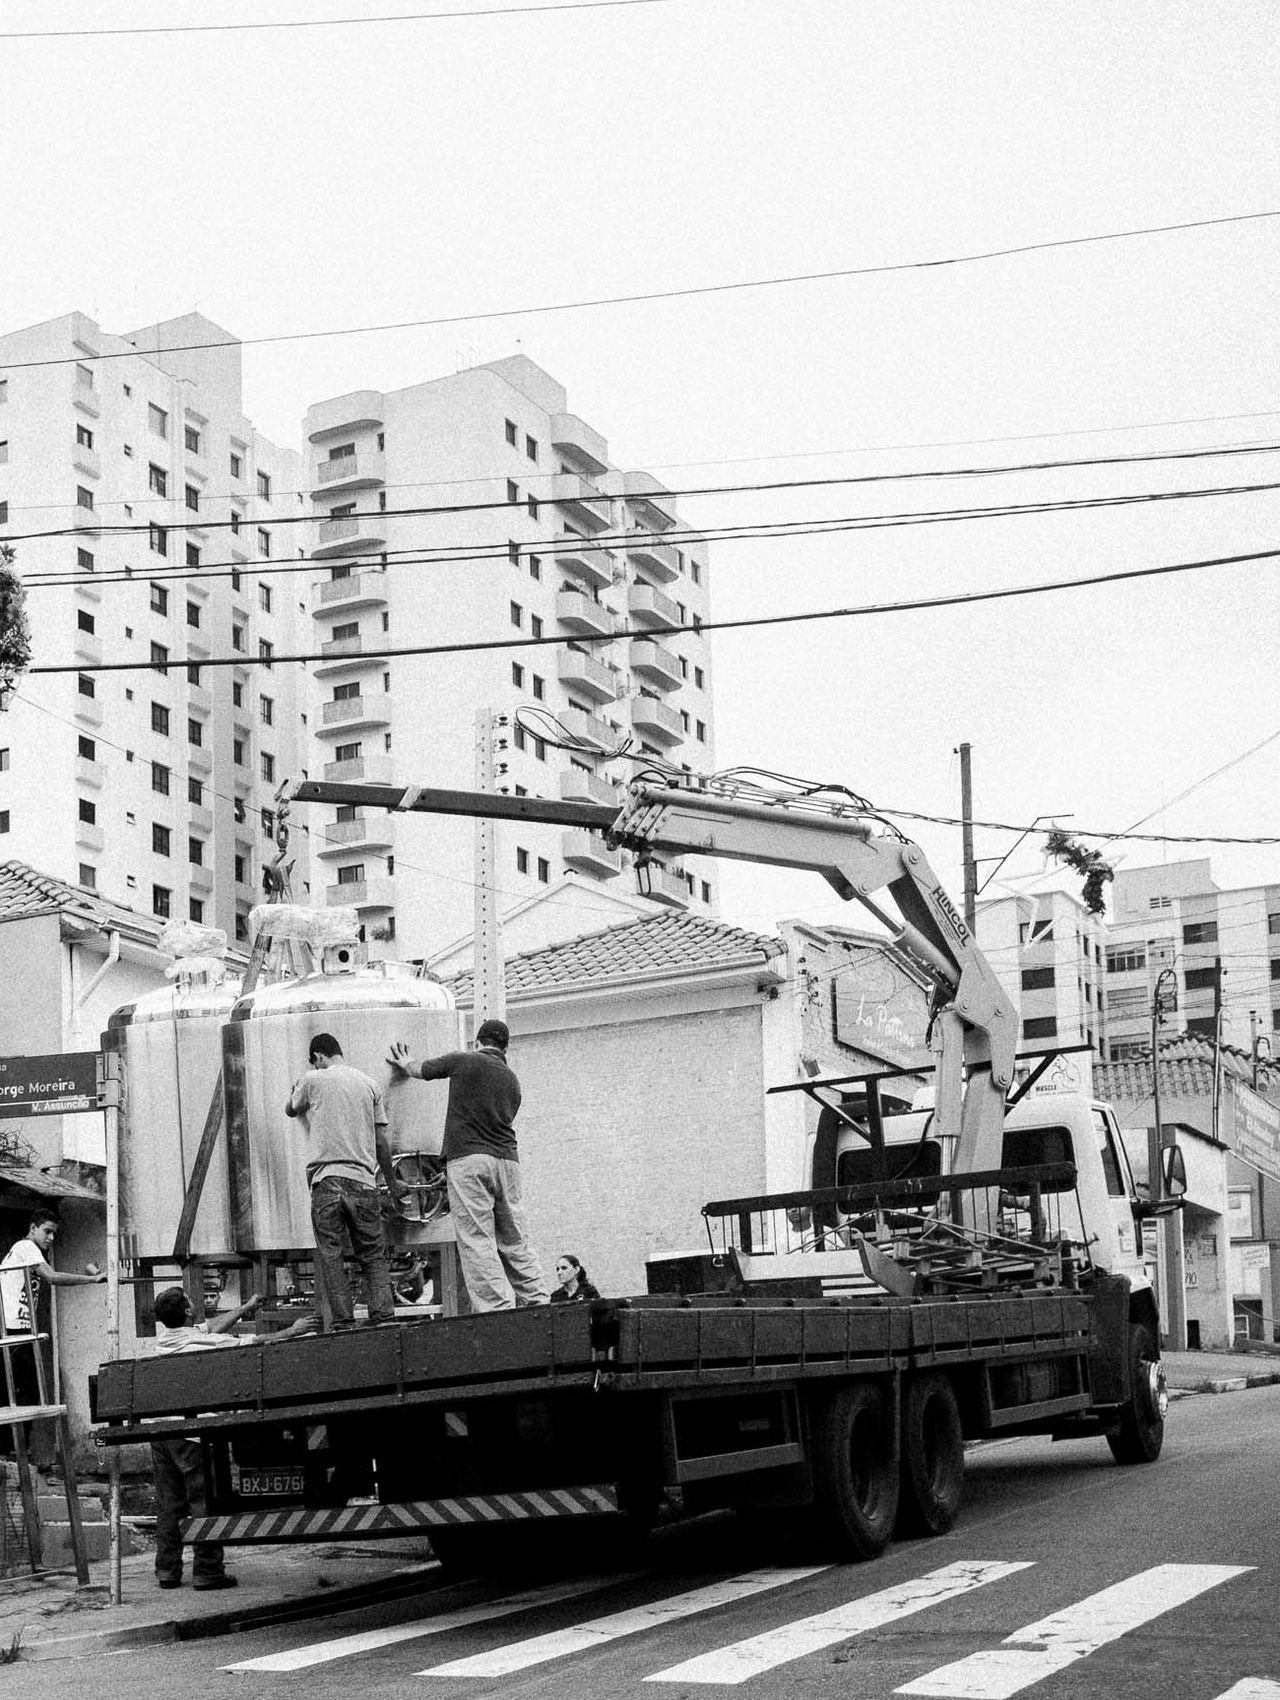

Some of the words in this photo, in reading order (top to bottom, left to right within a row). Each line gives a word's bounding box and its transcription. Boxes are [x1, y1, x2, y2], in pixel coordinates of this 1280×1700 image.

[932, 886, 970, 947] HINCOL
[29, 1078, 76, 1094] Moreira
[31, 1102, 41, 1112] V.
